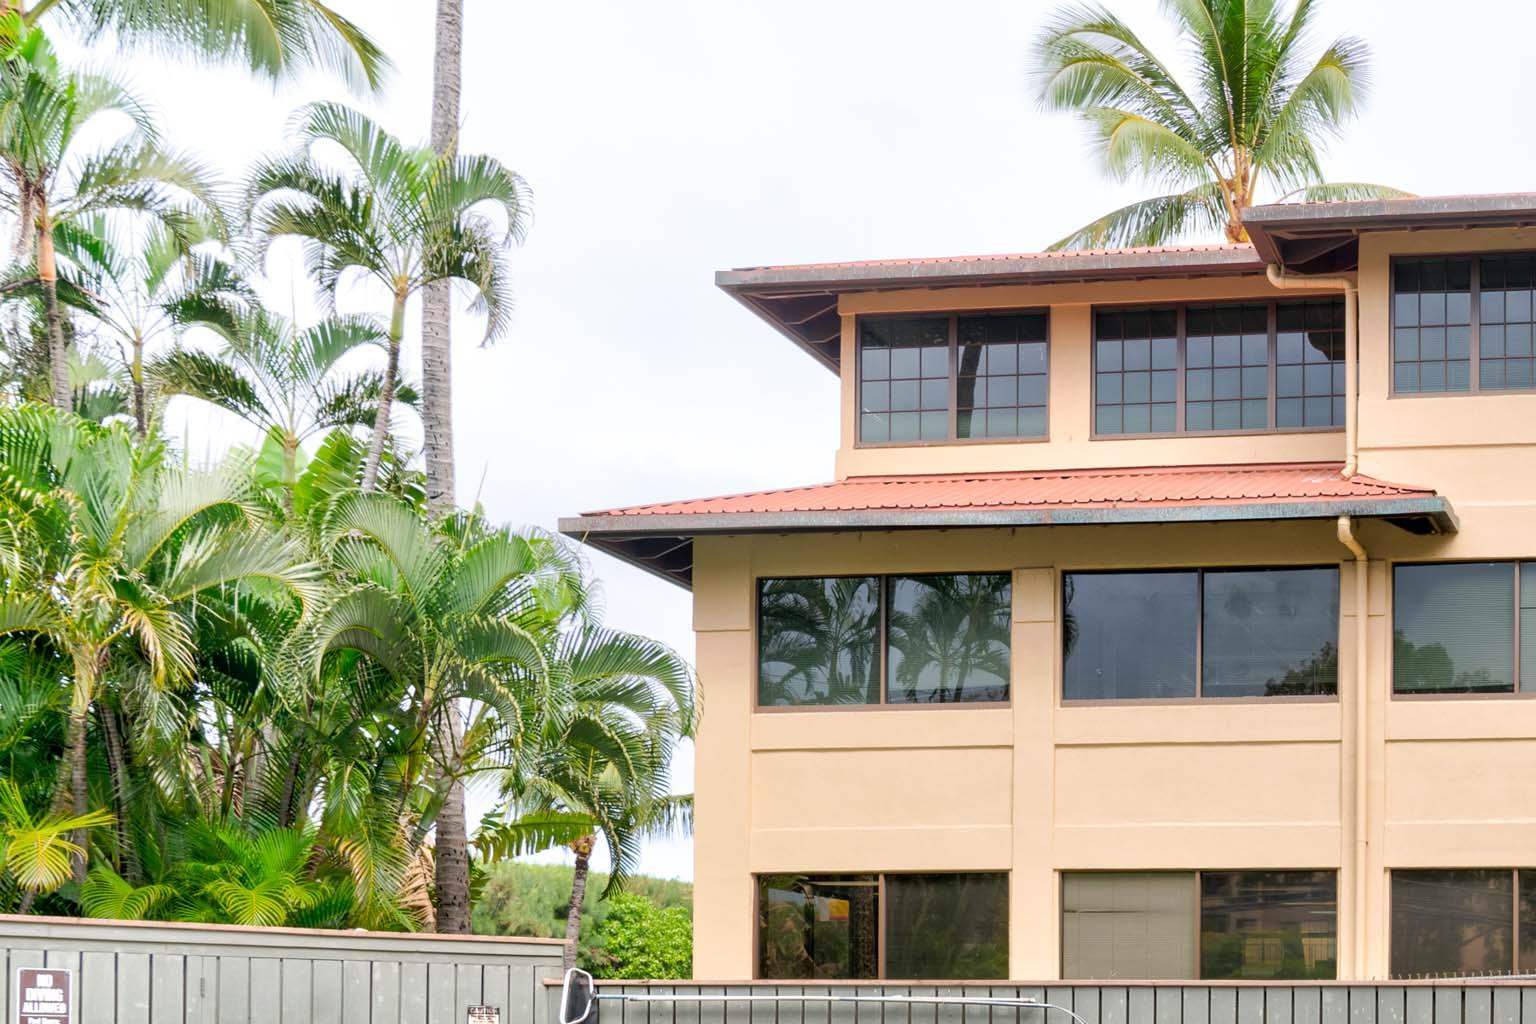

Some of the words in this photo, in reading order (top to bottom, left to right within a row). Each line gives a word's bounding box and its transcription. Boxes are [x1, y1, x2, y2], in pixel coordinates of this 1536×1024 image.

[36, 973, 54, 988] NO
[25, 988, 64, 1001] DIVING
[22, 1002, 67, 1013] ALLOWED
